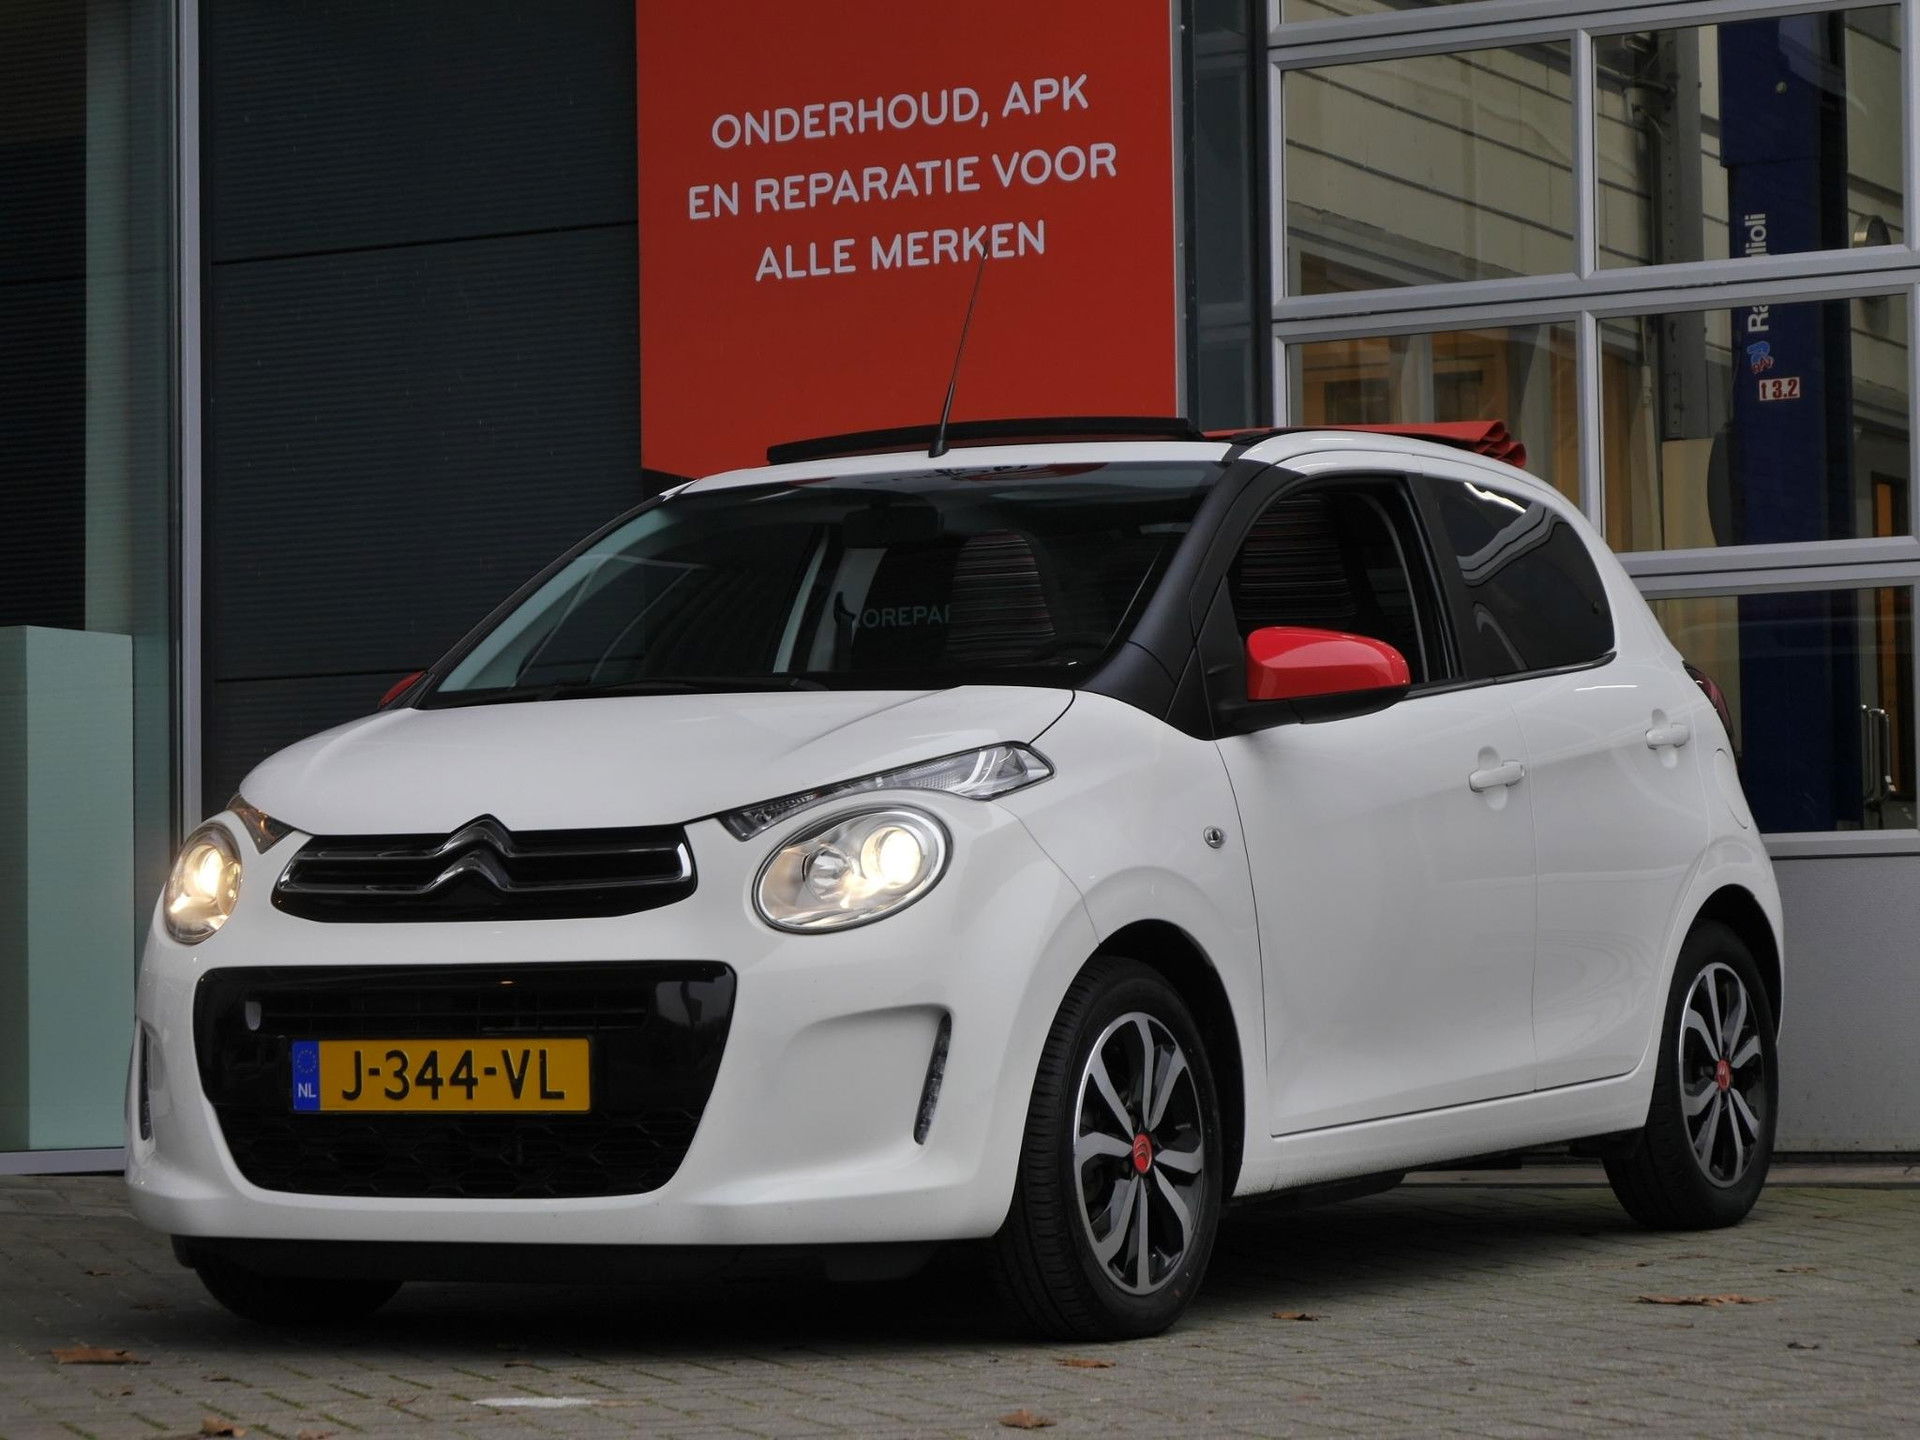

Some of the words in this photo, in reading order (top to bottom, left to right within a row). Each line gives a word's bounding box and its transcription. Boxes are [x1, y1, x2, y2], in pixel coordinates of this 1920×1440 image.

[711, 87, 989, 149] ONDERHOUD,
[1001, 73, 1089, 118] APK
[688, 181, 739, 220] EN
[754, 155, 981, 214] REPARATIE
[991, 142, 1117, 188] VOOR
[755, 238, 857, 282] ALLE
[871, 219, 1045, 271] MERKEN
[1772, 379, 1798, 399] 3.2
[298, 1083, 316, 1098] NL
[342, 1049, 565, 1101] J-344-VL
